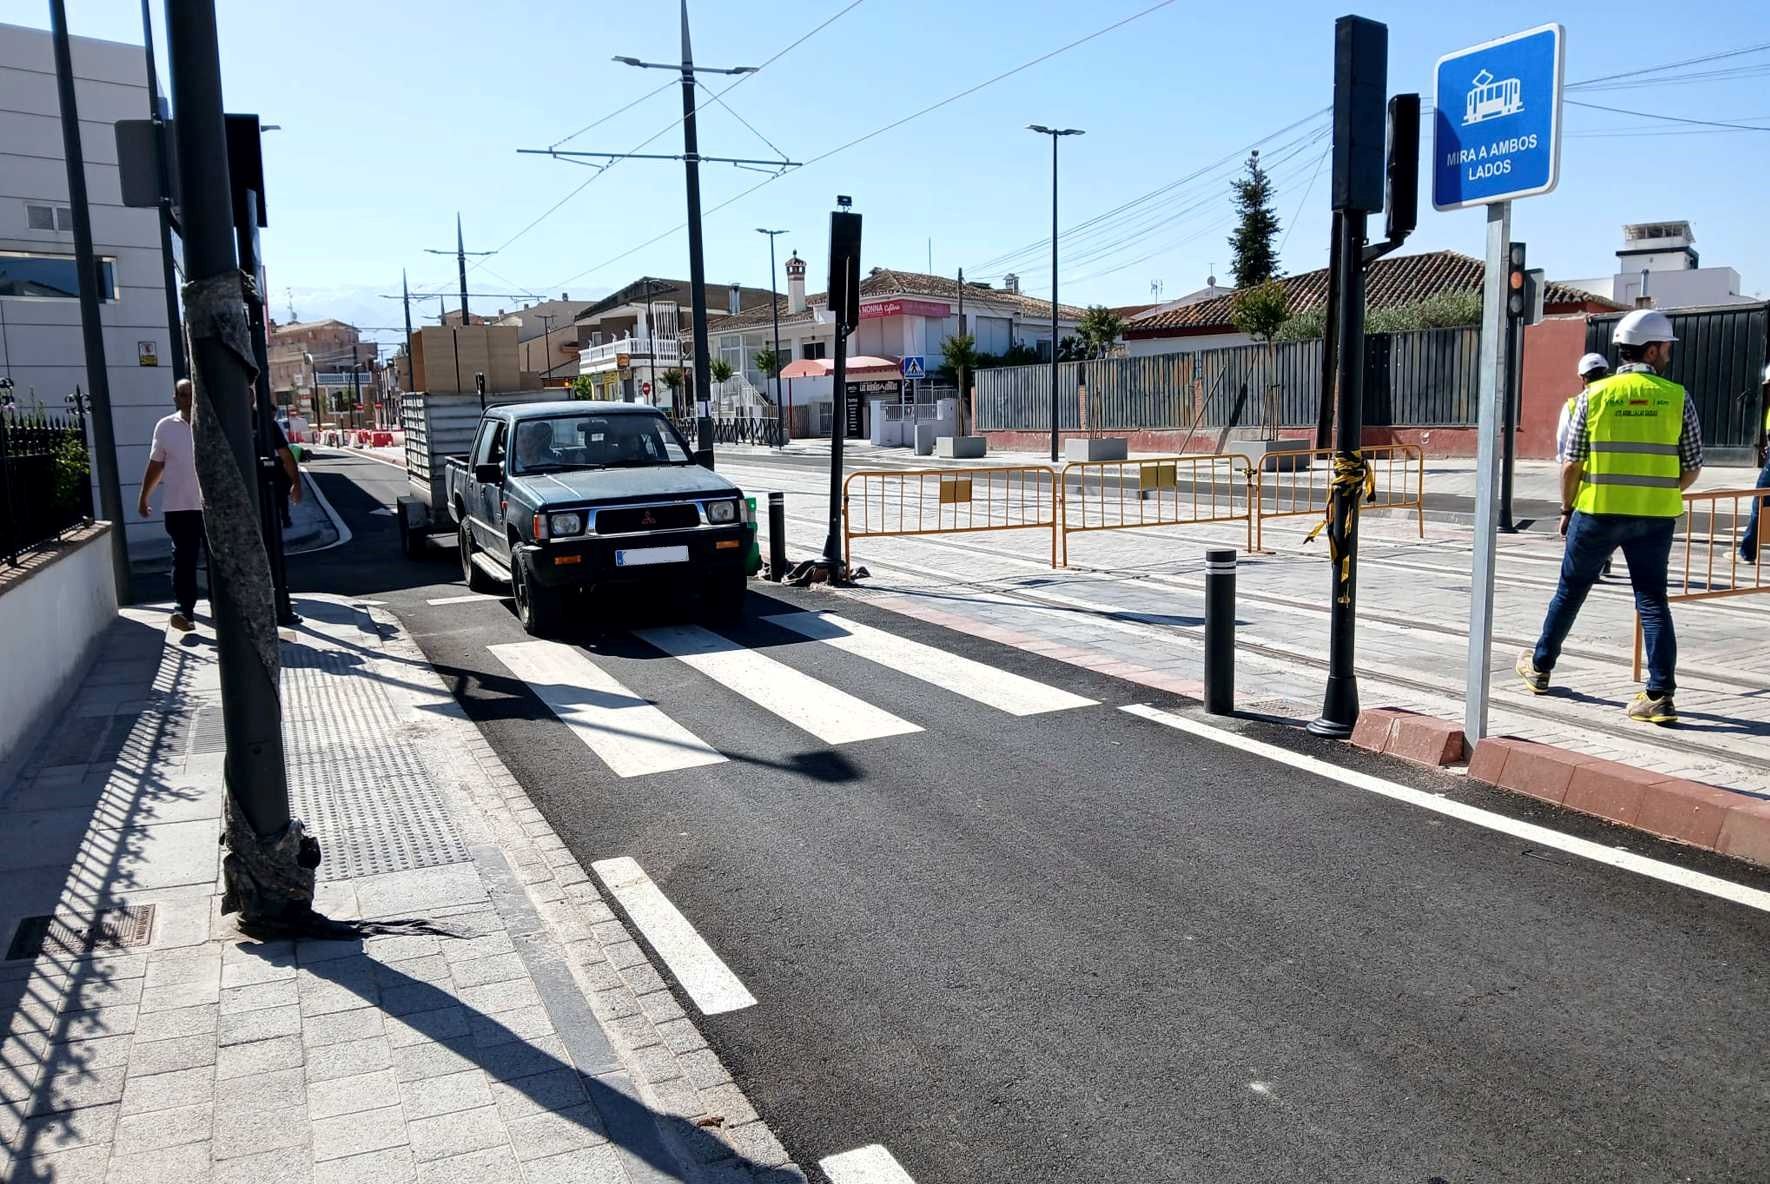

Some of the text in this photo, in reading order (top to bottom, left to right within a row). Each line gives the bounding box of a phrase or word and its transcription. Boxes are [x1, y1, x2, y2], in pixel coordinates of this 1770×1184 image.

[1447, 134, 1537, 167] MIRA A AMBOS
[1469, 159, 1512, 180] LADOS
[861, 303, 883, 313] NONNA
